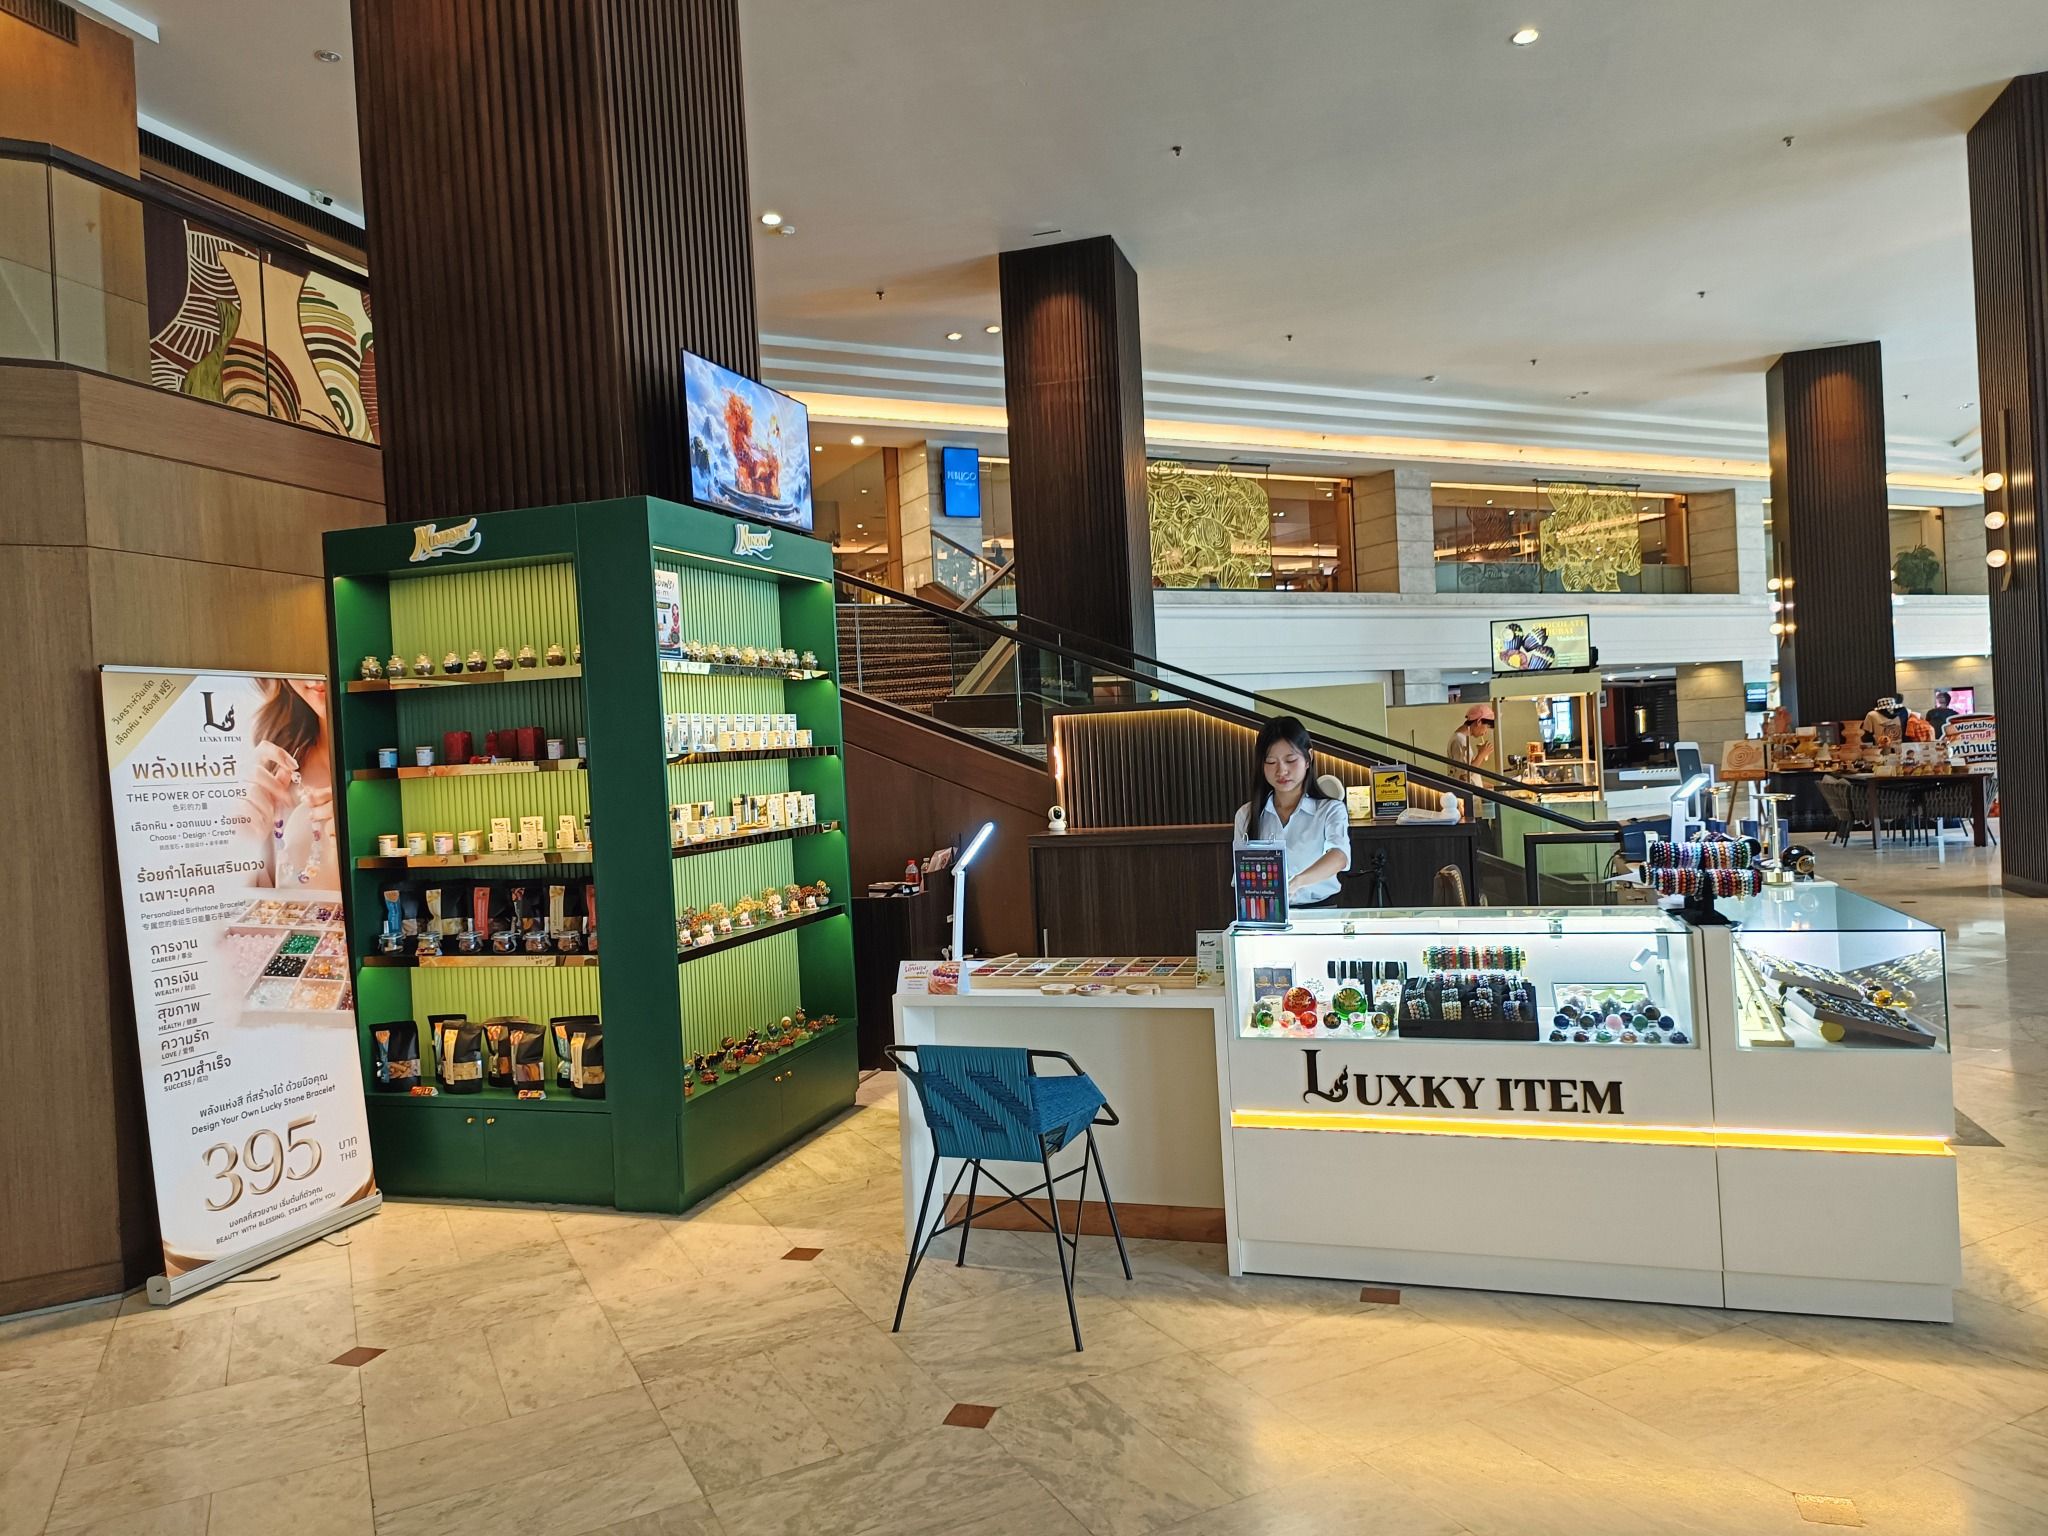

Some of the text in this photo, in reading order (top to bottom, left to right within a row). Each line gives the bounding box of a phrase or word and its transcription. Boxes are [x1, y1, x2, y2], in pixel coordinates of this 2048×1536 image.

[132, 754, 237, 780] พลังแห่งสี
[126, 788, 248, 803] THE POWER OF COLORS
[131, 820, 168, 832] เลือกหิน
[176, 819, 212, 829] ออกแบบ
[150, 829, 236, 842] Choose Design Create
[137, 860, 265, 883] ร้อยกำไลหินเสริมดวง
[140, 884, 215, 902] เฉพาะบุคคล
[141, 900, 246, 920] Personalized Birthstone Bracelet
[150, 939, 198, 956] การงาน
[152, 954, 176, 964] CAREER
[154, 970, 199, 988] การเงิน
[155, 988, 180, 997] WEALTH
[158, 1002, 200, 1024] สุขภาพ
[159, 1022, 182, 1032] HEALTH
[161, 1030, 209, 1050] ความรัก
[162, 1051, 178, 1060] LOVE
[164, 1054, 232, 1084] ความสำเร็จ
[164, 1080, 192, 1092] SUCCESS
[1301, 1049, 1624, 1115] LUXKY ITEM
[192, 1084, 336, 1136] Design Your Own Lucky Stone Bracelet
[200, 1096, 244, 1118] พลังแห่งสี
[338, 1136, 358, 1150] บาท
[202, 1114, 322, 1212] 395
[339, 1150, 358, 1162] THB
[216, 1232, 239, 1245] BEAUTY
[242, 1224, 257, 1234] WITH
[288, 1203, 308, 1216] STARTS
[310, 1198, 323, 1206] WITH
[325, 1192, 336, 1200] YOU
